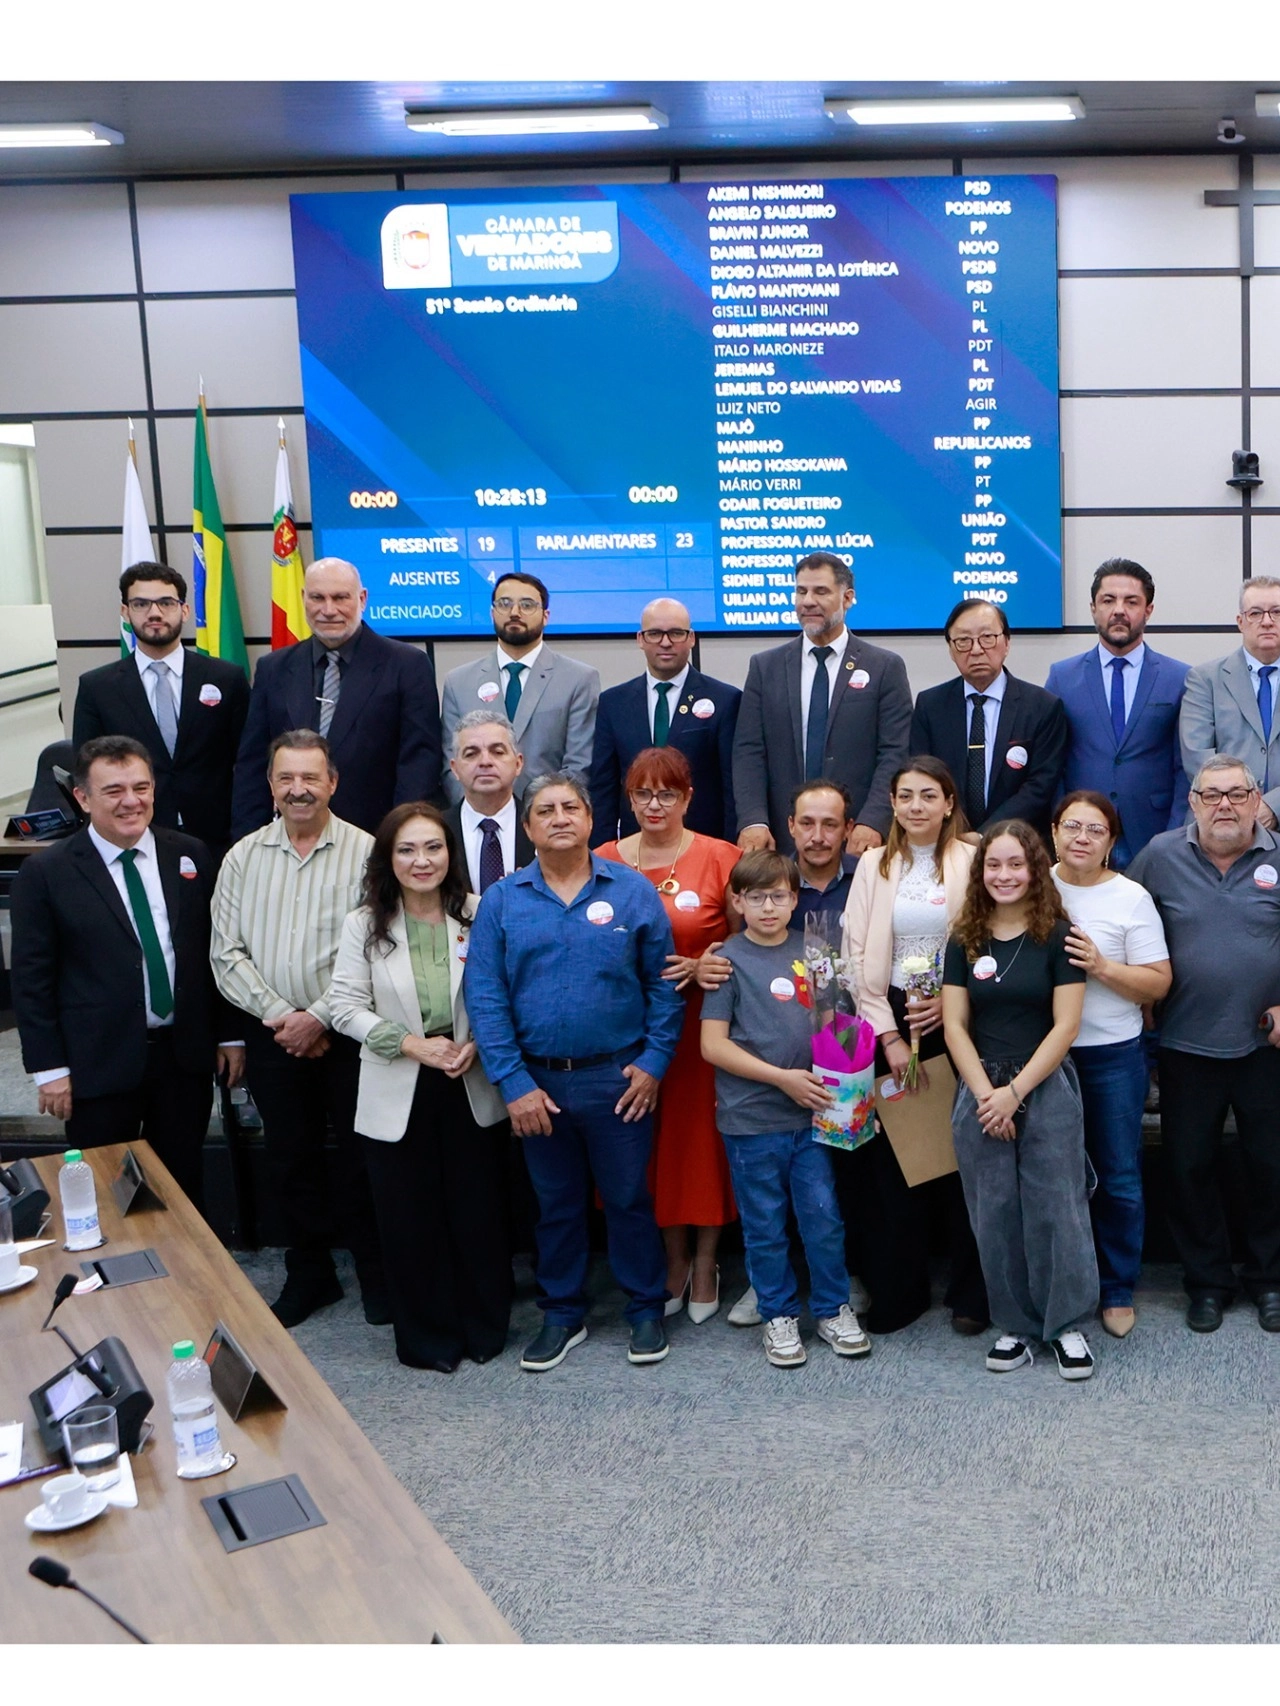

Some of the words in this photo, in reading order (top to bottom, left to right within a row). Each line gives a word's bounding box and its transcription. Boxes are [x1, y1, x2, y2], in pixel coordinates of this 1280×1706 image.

[708, 186, 749, 201] AKEMI
[752, 185, 823, 200] NISHIMORI
[965, 182, 990, 195] PSD
[708, 206, 761, 221] ANGELO
[764, 205, 836, 219] SALGUEIRO
[946, 201, 1011, 215] PODEMOS
[485, 215, 557, 233] CÂMARA
[560, 216, 581, 231] DE
[970, 221, 987, 234] PP
[710, 226, 757, 240] BRAVIN
[760, 225, 809, 239] JUNIOR
[456, 230, 613, 257] VEREADORES
[959, 241, 999, 254] NOVO
[710, 245, 758, 260] DANIEL
[760, 244, 823, 258] MALVEZZI
[487, 256, 508, 271] DE
[510, 252, 582, 271] MARINGÁ
[962, 260, 996, 274] PSDB
[711, 265, 754, 279] DIOGO
[757, 264, 813, 278] ALTAMIR
[816, 264, 835, 277] DA
[839, 260, 898, 276] LOTÉRICA
[712, 283, 756, 299] FLÁVIO
[759, 283, 839, 298] MANTOVANI
[967, 280, 992, 293] PSD
[506, 295, 577, 311] Ordinária
[973, 301, 986, 312] PL
[713, 305, 756, 317] GISELLI
[761, 304, 827, 316] BIANCHINI
[713, 323, 787, 338] GUILHERME
[790, 322, 859, 336] MACHADO
[973, 320, 988, 332] PL
[715, 344, 749, 356] ITALO
[754, 343, 823, 355] MARONEZE
[969, 340, 992, 351] PDT
[715, 363, 775, 376] JEREMIAS
[973, 359, 988, 371] PL
[716, 382, 764, 396] LEMUEL
[767, 382, 787, 394] DO
[790, 381, 859, 394] SALVANDO
[861, 379, 901, 393] VIDAS
[969, 378, 994, 391] PDT
[717, 403, 742, 414] LUIZ
[748, 402, 780, 413] NETO
[966, 398, 996, 409] AGIR
[974, 417, 990, 429] PP
[718, 440, 783, 453] MANINHO
[934, 436, 1031, 449] REPUBLICANOS
[719, 458, 762, 472] MÁRIO
[765, 458, 847, 471] HOSSOKAWA
[975, 456, 991, 468] PP
[720, 478, 762, 490] MÁRIO
[766, 479, 800, 490] VERRI
[976, 476, 990, 486] PT
[350, 491, 397, 508] 00:00
[475, 489, 546, 505] 10:28:13
[629, 486, 677, 502] 00:00
[976, 495, 992, 506] PP
[720, 498, 760, 510] ODAIR
[764, 497, 841, 510] FOGUETEIRO
[721, 517, 768, 529] PASTOR
[771, 516, 825, 529] SANDRO
[962, 512, 1006, 526] UNIÃO
[381, 537, 458, 553] PRESENTES
[478, 537, 495, 551] 19
[537, 534, 656, 550] PARLAMENTARES
[676, 533, 693, 547] 23
[722, 536, 801, 548] PROFESSORA
[804, 536, 833, 547] ANA
[836, 533, 873, 547] LÚCIA
[972, 533, 997, 545] PDT
[722, 555, 793, 567] PROFESSOR
[966, 552, 1004, 564] NOVO
[390, 572, 459, 584] AUSENTES
[488, 571, 496, 583] 4
[723, 574, 764, 586] SIDNEI
[766, 574, 795, 587] TELL
[954, 572, 1017, 583] PODEMOS
[769, 593, 788, 605] DA
[370, 604, 462, 619] LICENCIADOS
[723, 611, 780, 625] WILLIAM
